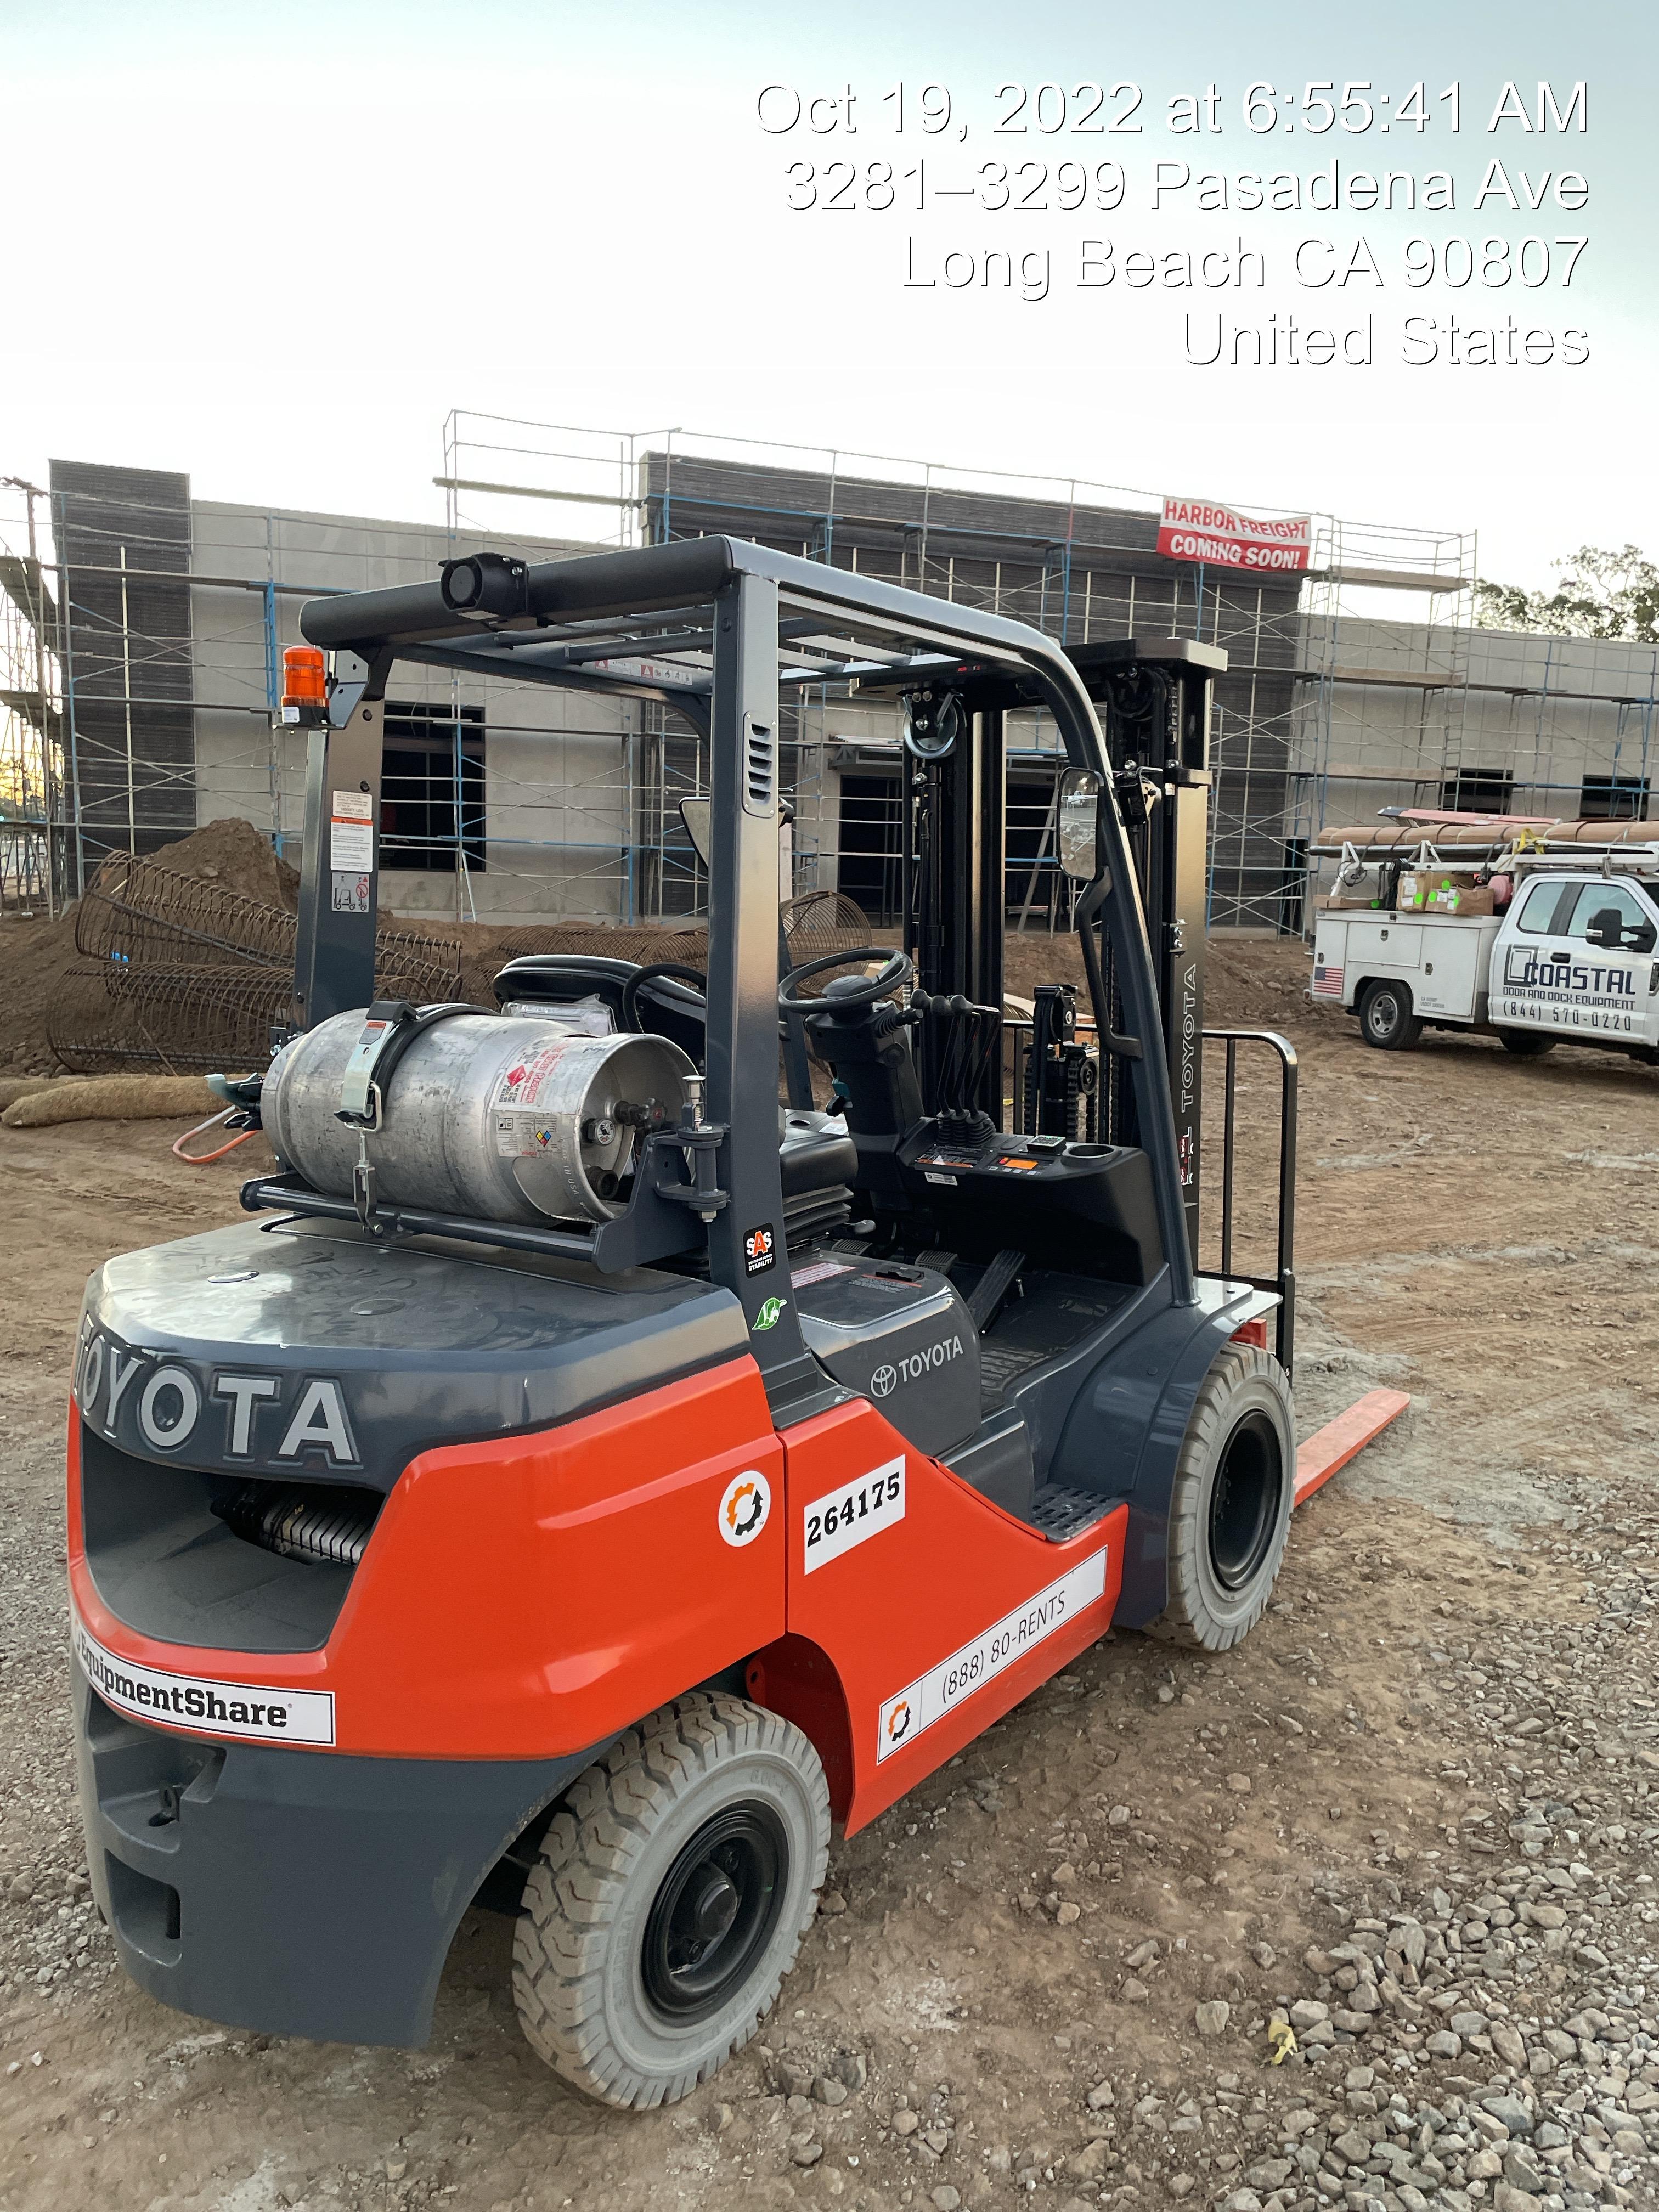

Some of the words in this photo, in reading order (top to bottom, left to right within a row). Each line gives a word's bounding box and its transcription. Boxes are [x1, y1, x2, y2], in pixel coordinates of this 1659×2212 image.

[1164, 500, 1237, 532] HARBOR
[1239, 518, 1309, 539] FREIGHT
[1170, 534, 1242, 563] COMING
[1245, 547, 1301, 569] SOON!
[1523, 962, 1636, 995] COASTAL
[1503, 986, 1526, 997] DOOR
[1528, 990, 1545, 1000] AND
[1548, 992, 1573, 1003] DOCK
[1575, 995, 1636, 1011] EQUIPMENT
[1503, 1000, 1542, 1021] (844)
[1553, 1007, 1631, 1031] 570-0220
[1181, 963, 1197, 1113] TOYOTA
[563, 1165, 572, 1175] IN
[567, 1178, 580, 1195] USA
[746, 1231, 772, 1257] SAS
[748, 1257, 773, 1272] STABILITY
[899, 1335, 963, 1383] TOYOTA
[72, 1313, 353, 1462] TOYOTA
[806, 1471, 900, 1548] 264175
[942, 1651, 985, 1703] (888)
[991, 1590, 1065, 1663] 80-RENTS
